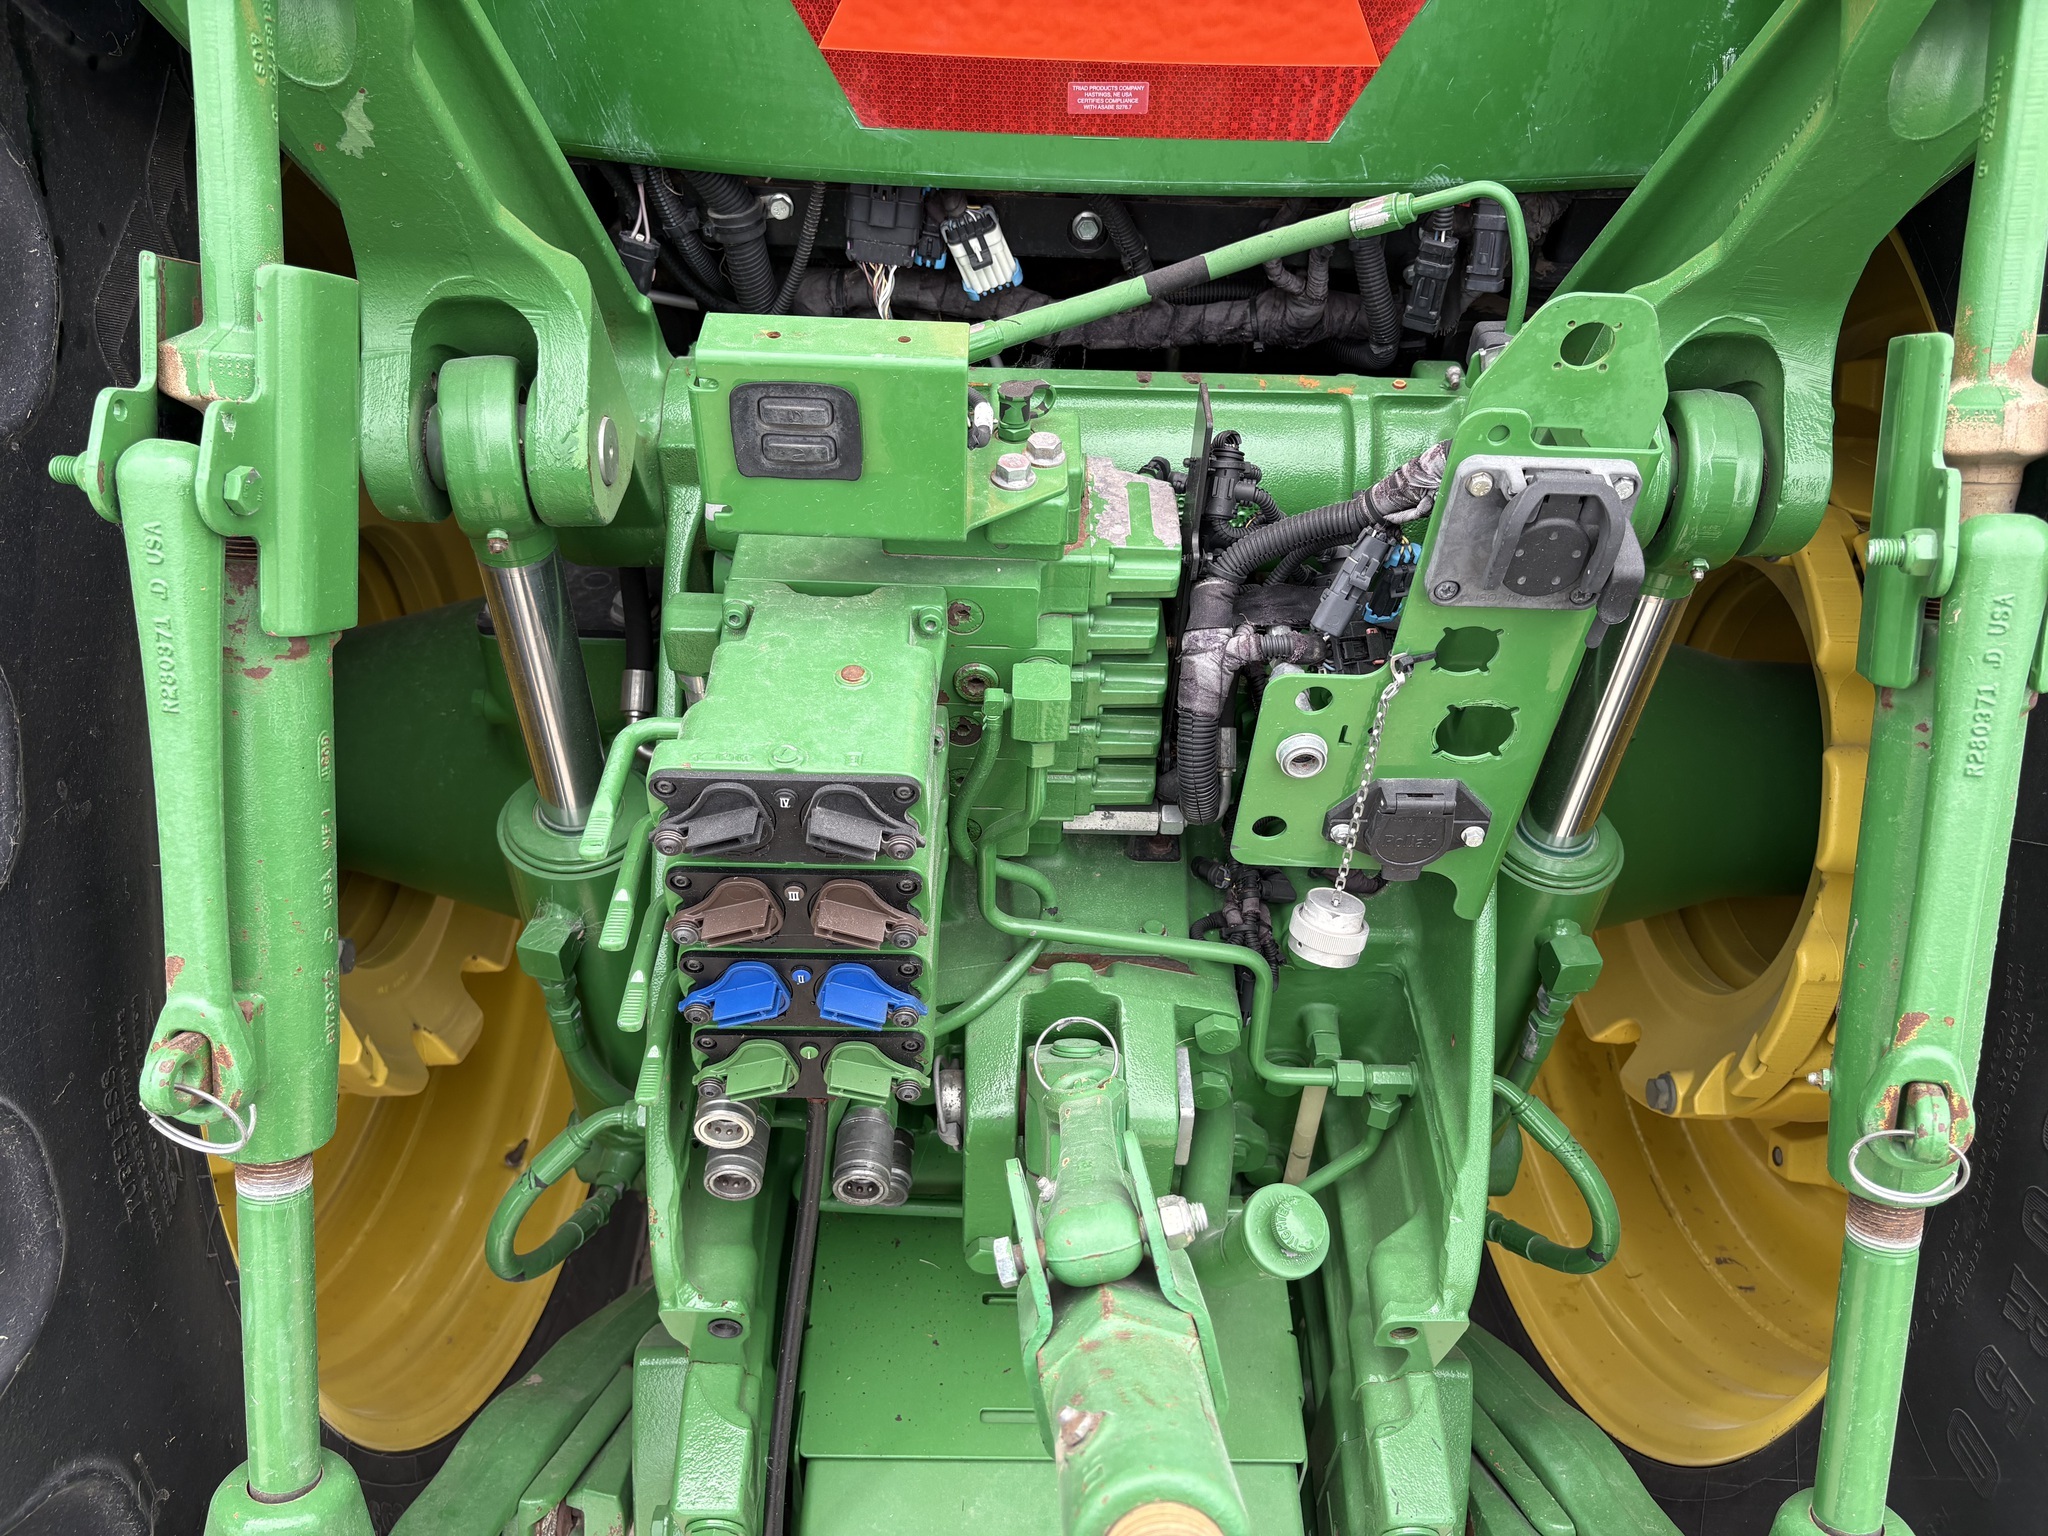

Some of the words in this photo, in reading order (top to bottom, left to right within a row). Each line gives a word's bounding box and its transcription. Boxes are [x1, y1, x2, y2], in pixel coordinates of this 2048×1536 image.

[143, 521, 165, 566] USA
[1963, 682, 1999, 778] R280371
[1986, 593, 2016, 636] USA
[779, 797, 791, 809] IV
[788, 891, 800, 901] III
[797, 974, 805, 985] II
[101, 1065, 142, 1223] TUBELESS
